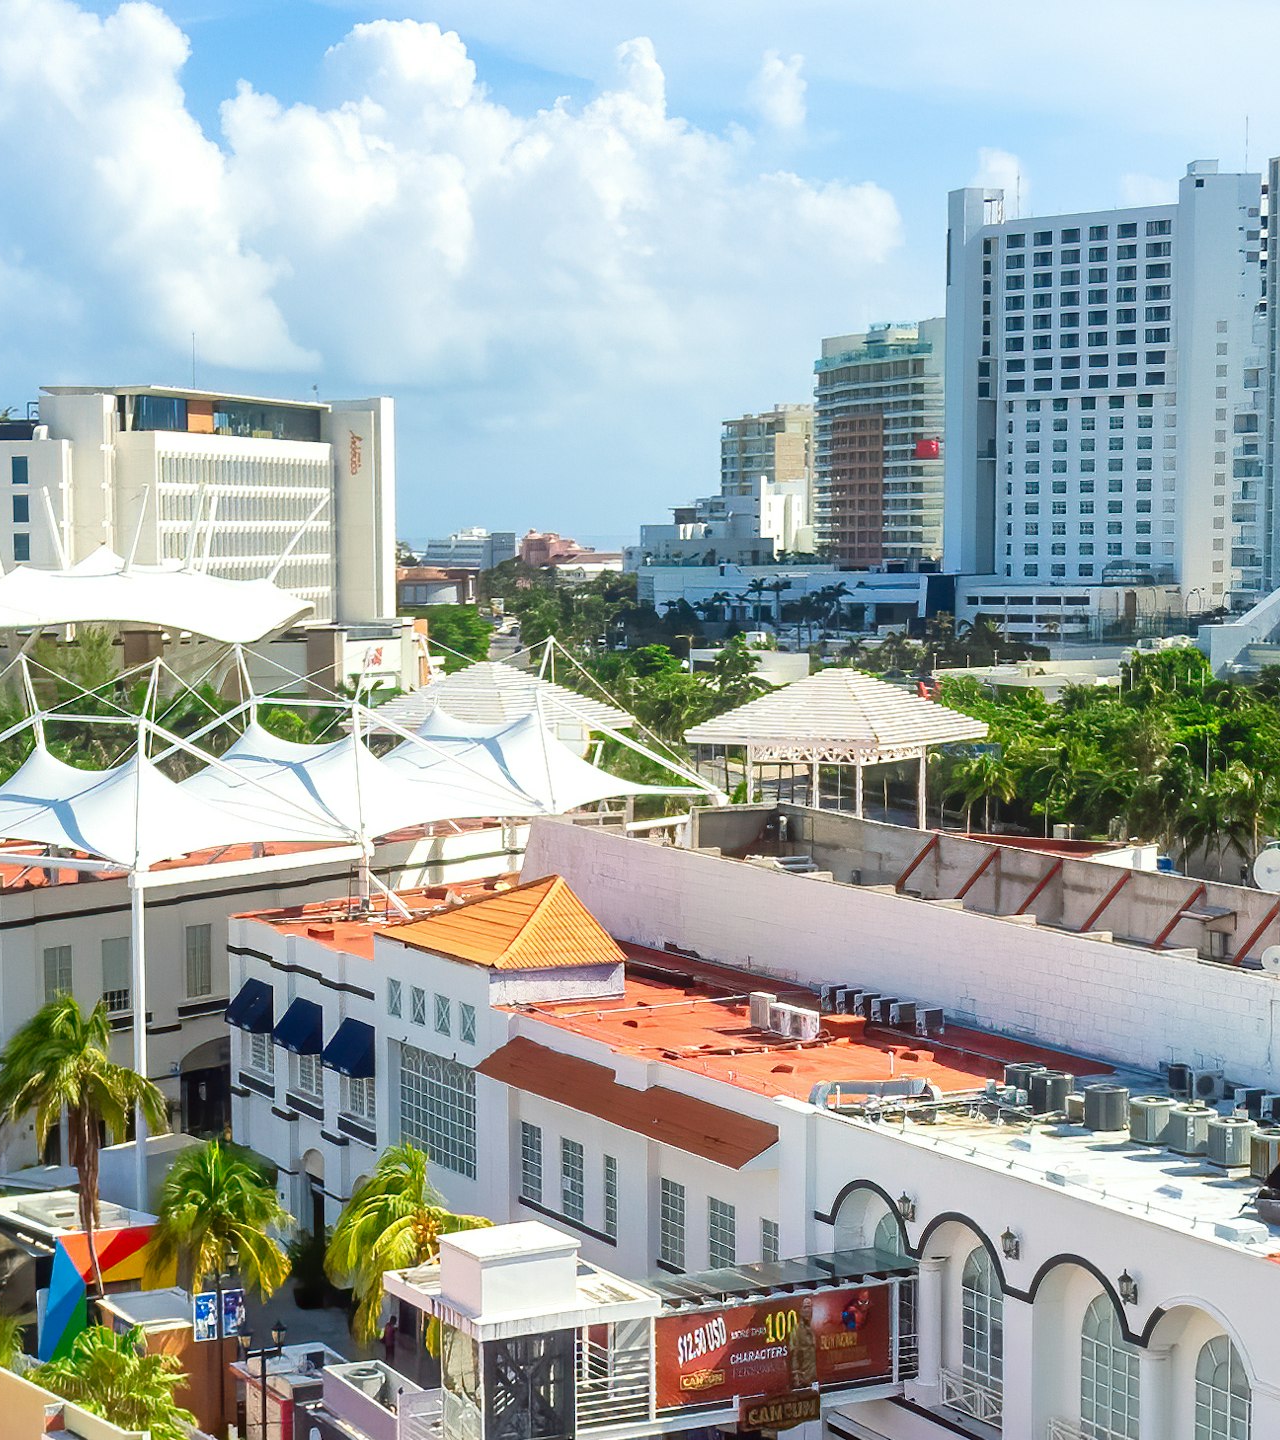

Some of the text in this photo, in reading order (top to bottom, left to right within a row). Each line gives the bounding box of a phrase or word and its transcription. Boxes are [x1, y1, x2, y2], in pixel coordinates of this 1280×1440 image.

[677, 1316, 727, 1368] $12.50 USD
[765, 1309, 798, 1343] 100
[730, 1345, 788, 1365] CHARACTERS
